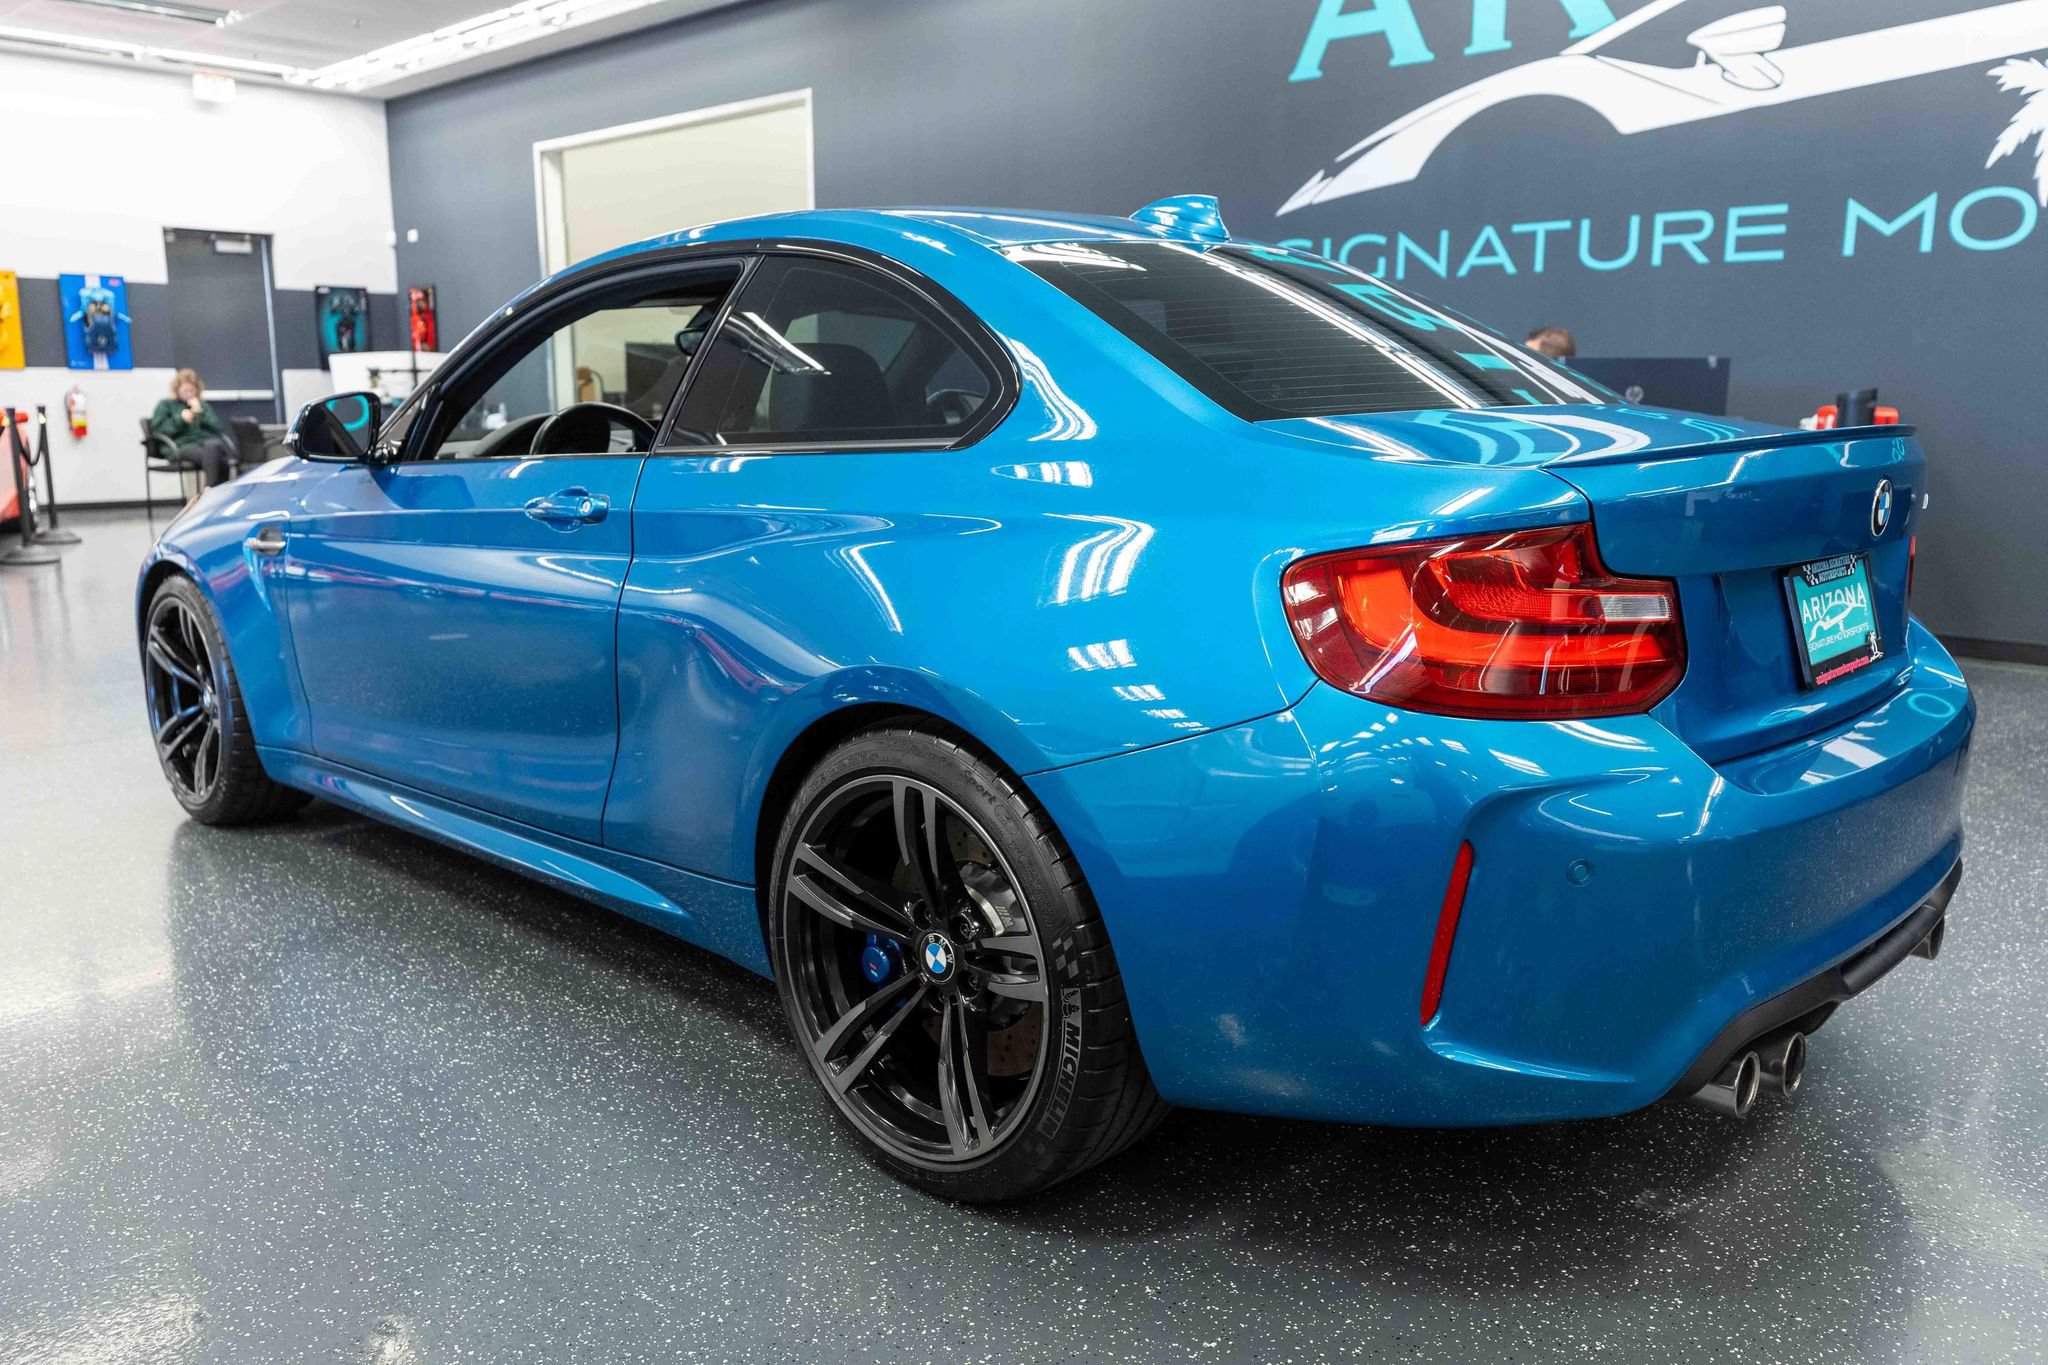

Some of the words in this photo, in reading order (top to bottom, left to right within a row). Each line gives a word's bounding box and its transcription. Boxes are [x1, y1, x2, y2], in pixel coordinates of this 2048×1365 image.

[1802, 582, 1866, 624] ARIZONA
[928, 934, 954, 964] BMW
[1041, 1021, 1081, 1136] MICHELIN
